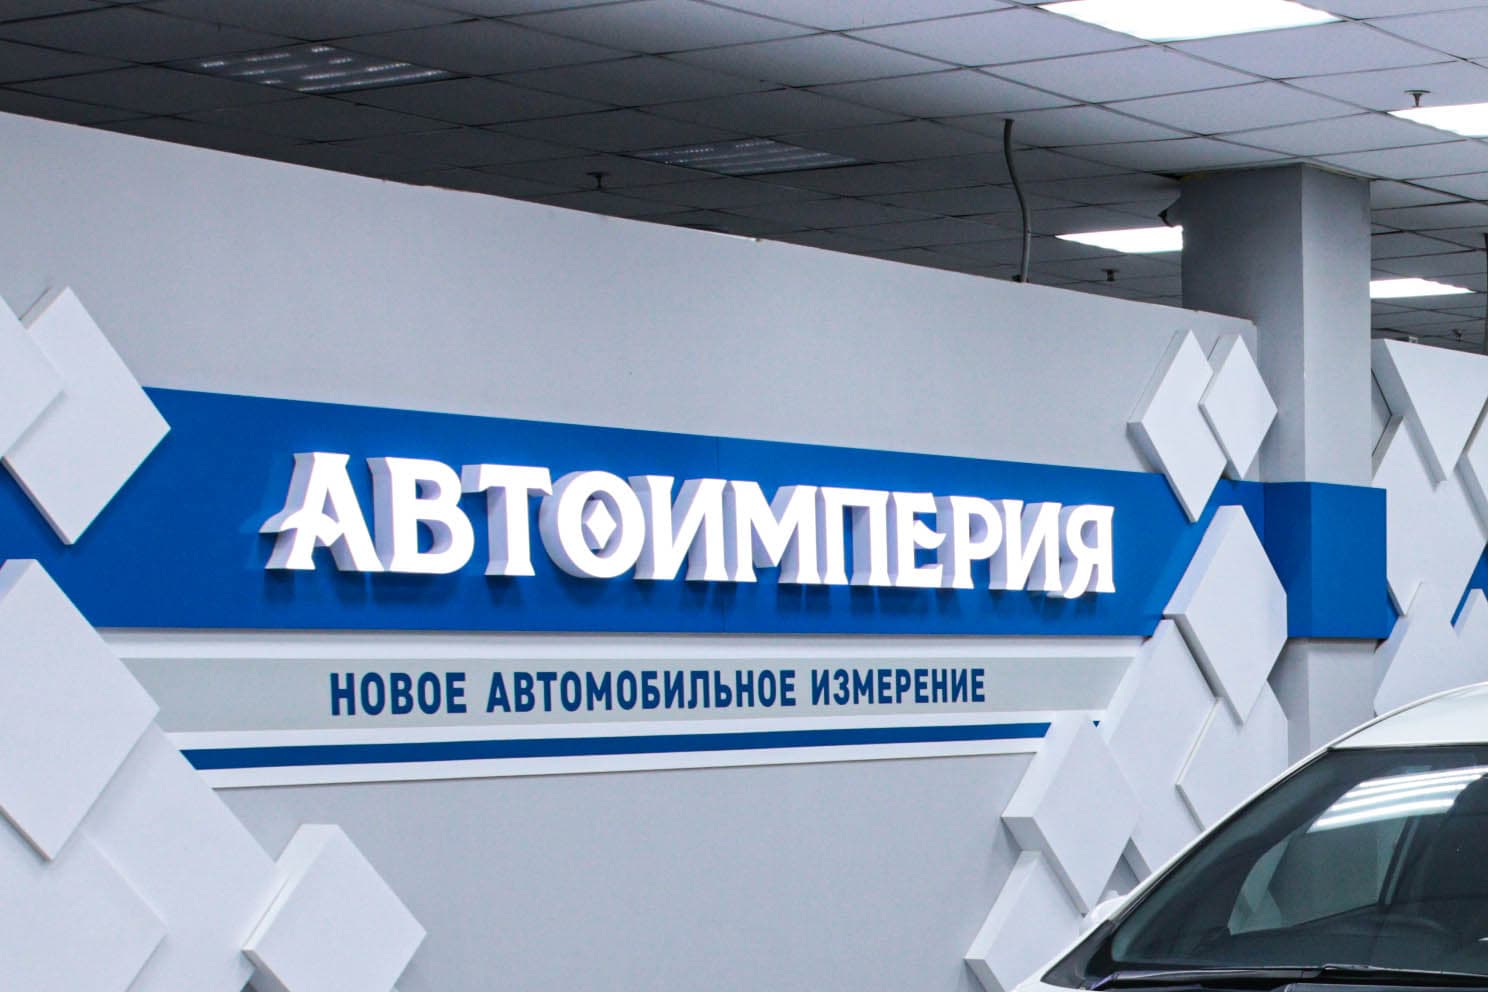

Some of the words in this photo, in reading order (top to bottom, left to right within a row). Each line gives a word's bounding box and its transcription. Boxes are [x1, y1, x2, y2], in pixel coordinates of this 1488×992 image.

[260, 451, 1116, 600] АВТОИМПЕРИЯ
[329, 670, 468, 717] НОВОЕ
[486, 669, 796, 714] АВТОМОБИЛЬНОЕ
[810, 667, 986, 707] ИЗМЕРЕНИЕ
